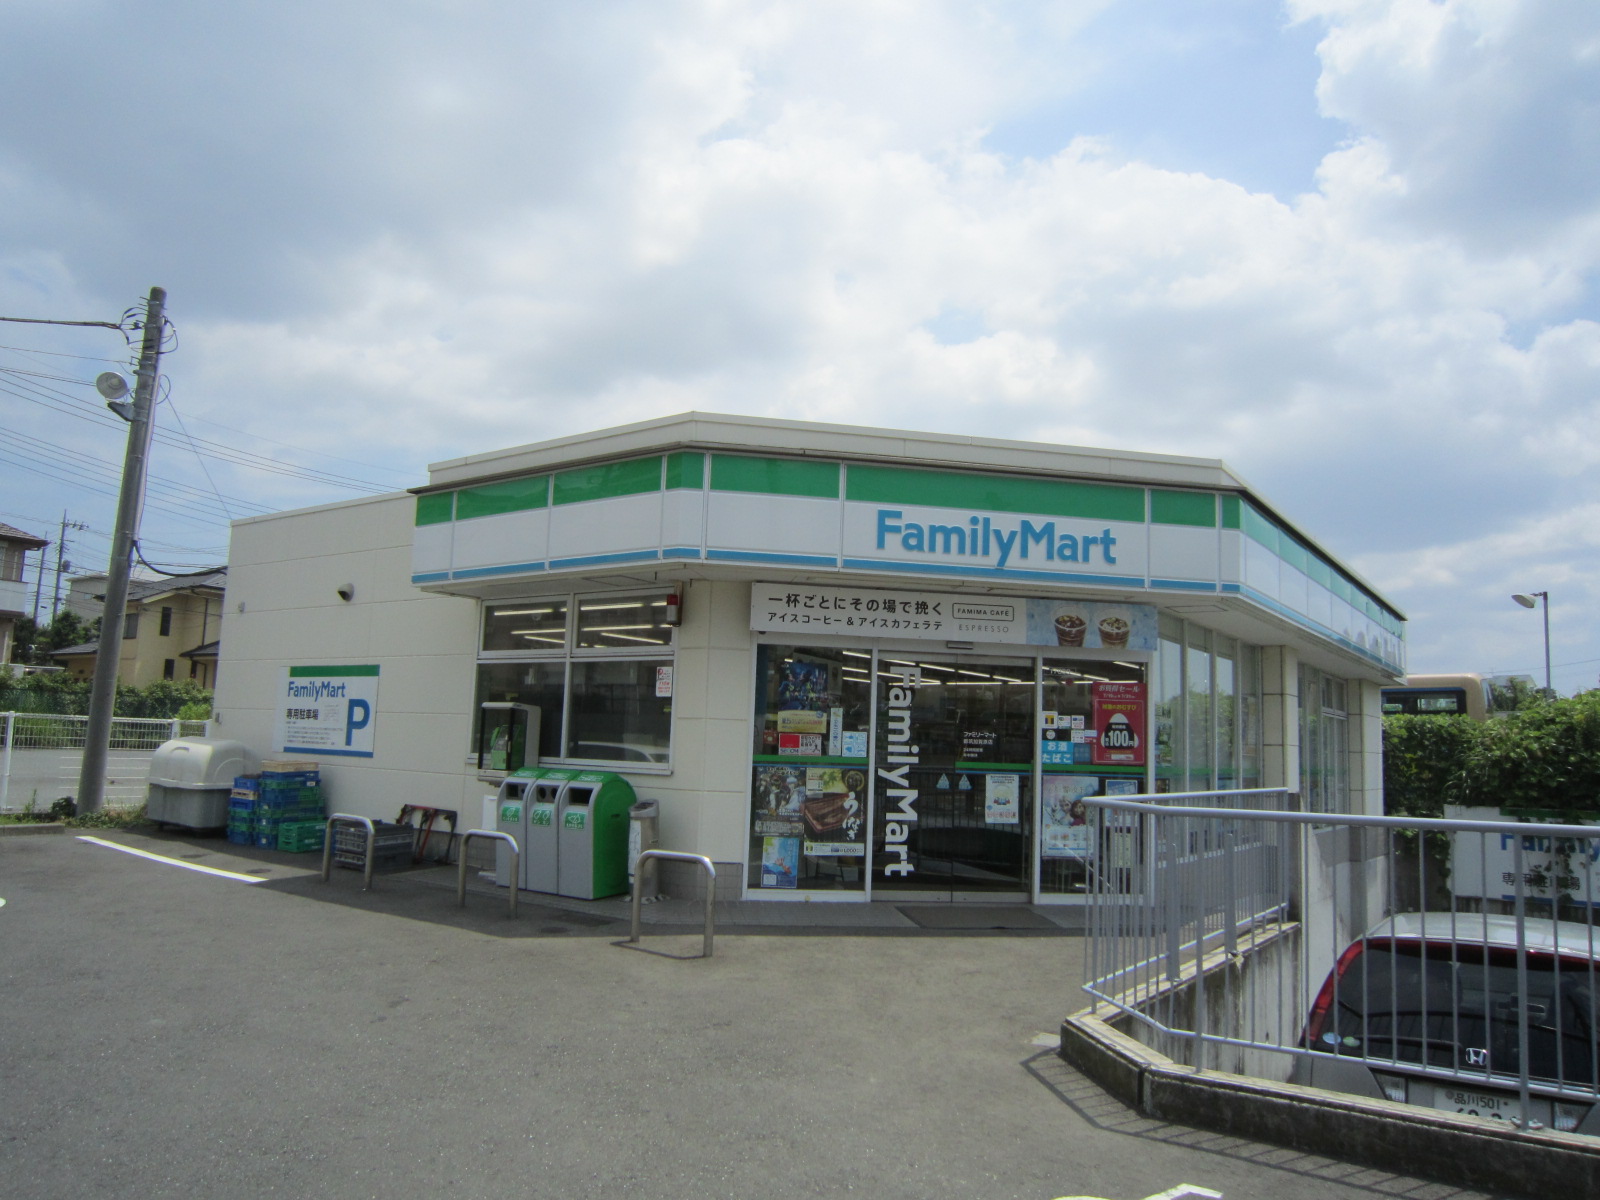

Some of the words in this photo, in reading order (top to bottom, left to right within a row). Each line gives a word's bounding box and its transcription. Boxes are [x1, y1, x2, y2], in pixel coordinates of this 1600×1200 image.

[876, 509, 1117, 569] FamilyMart
[768, 593, 943, 616] 一杯ごとにその場で挽く
[957, 608, 984, 616] FAMIMA
[767, 612, 842, 625] アイスコーヒー
[846, 616, 855, 627] &
[858, 616, 943, 631] アイスカフェラテ
[958, 623, 1010, 633] ESPRESSO
[288, 681, 346, 702] FamilyMart
[286, 708, 319, 721] 専用駐車場
[345, 699, 371, 746] P
[963, 731, 997, 739] ファミリーマート
[1047, 742, 1067, 751] お酒
[1042, 753, 1071, 763] たばこ
[878, 666, 921, 877] FamilyMart
